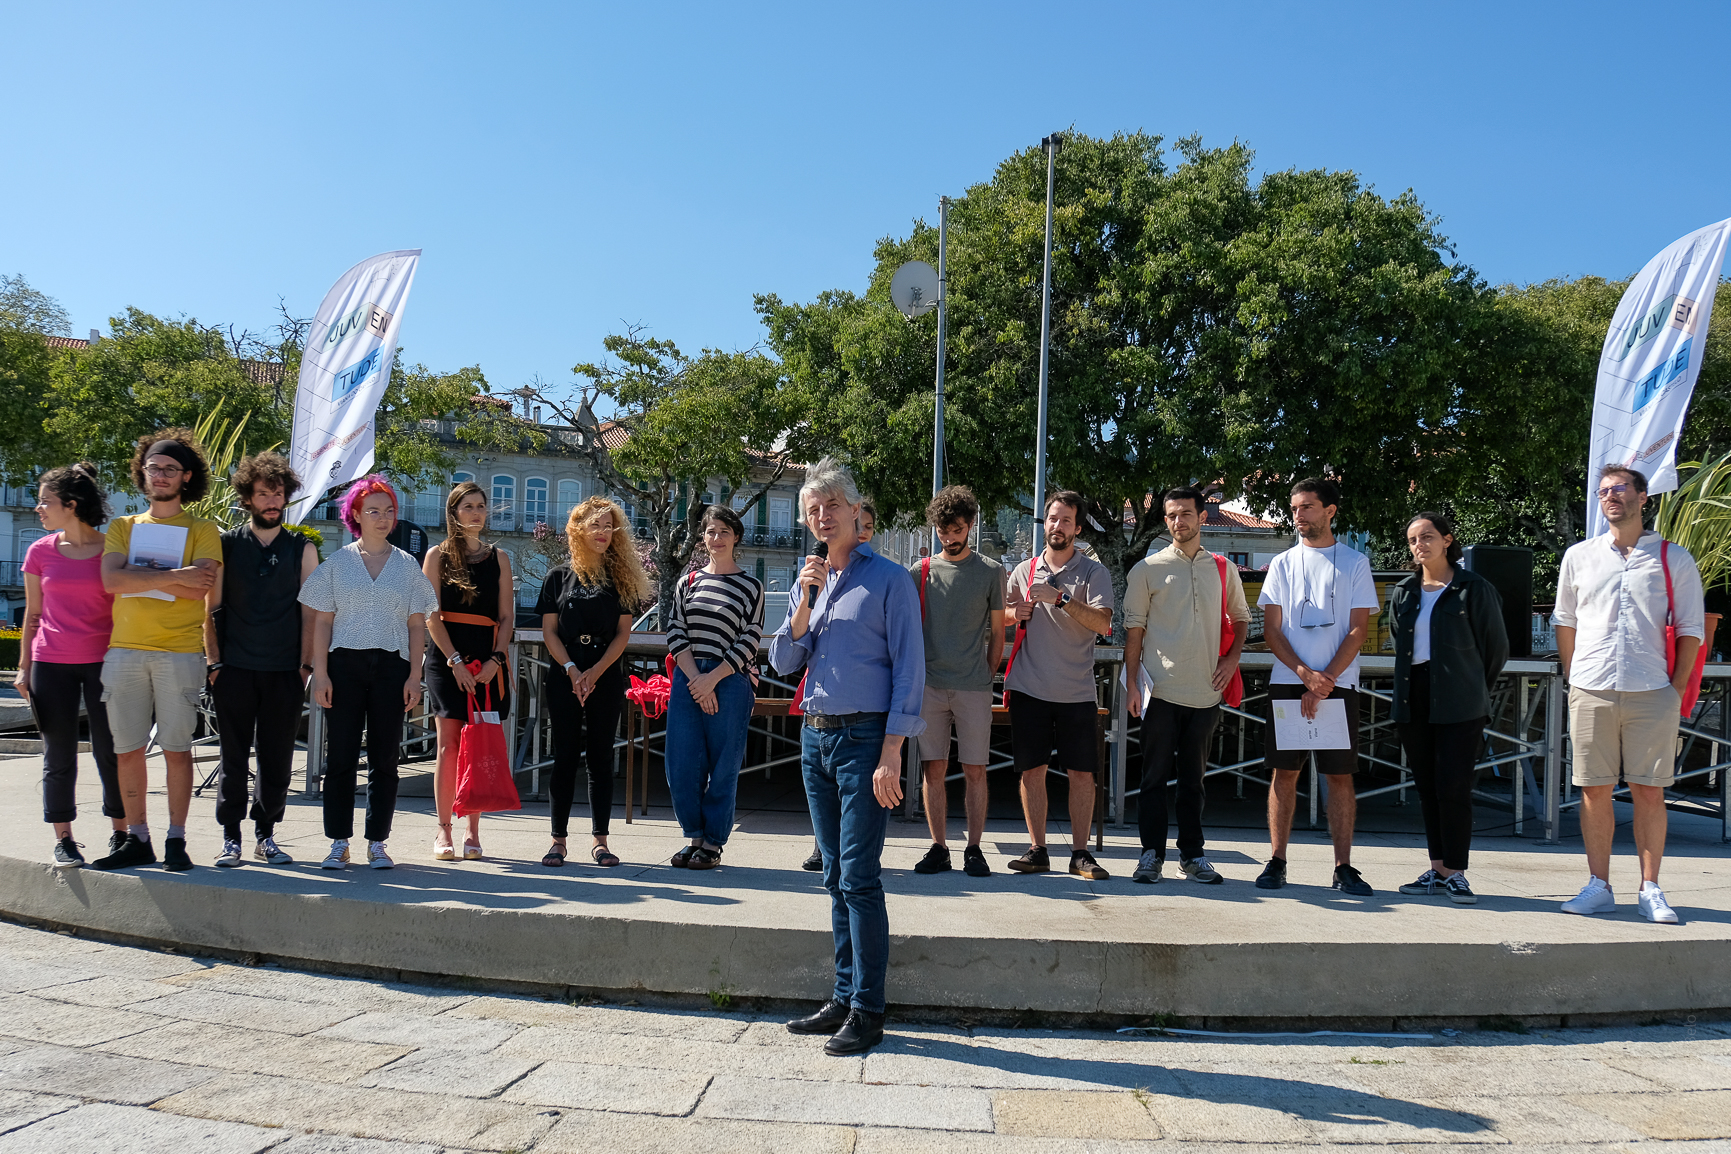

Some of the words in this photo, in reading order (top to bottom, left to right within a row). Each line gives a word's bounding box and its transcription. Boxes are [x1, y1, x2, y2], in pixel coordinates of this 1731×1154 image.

[329, 311, 363, 343] JUV
[370, 310, 389, 334] EN
[1628, 306, 1666, 349] JUV
[340, 352, 380, 390] TUDE
[1641, 348, 1687, 398] TUDE
